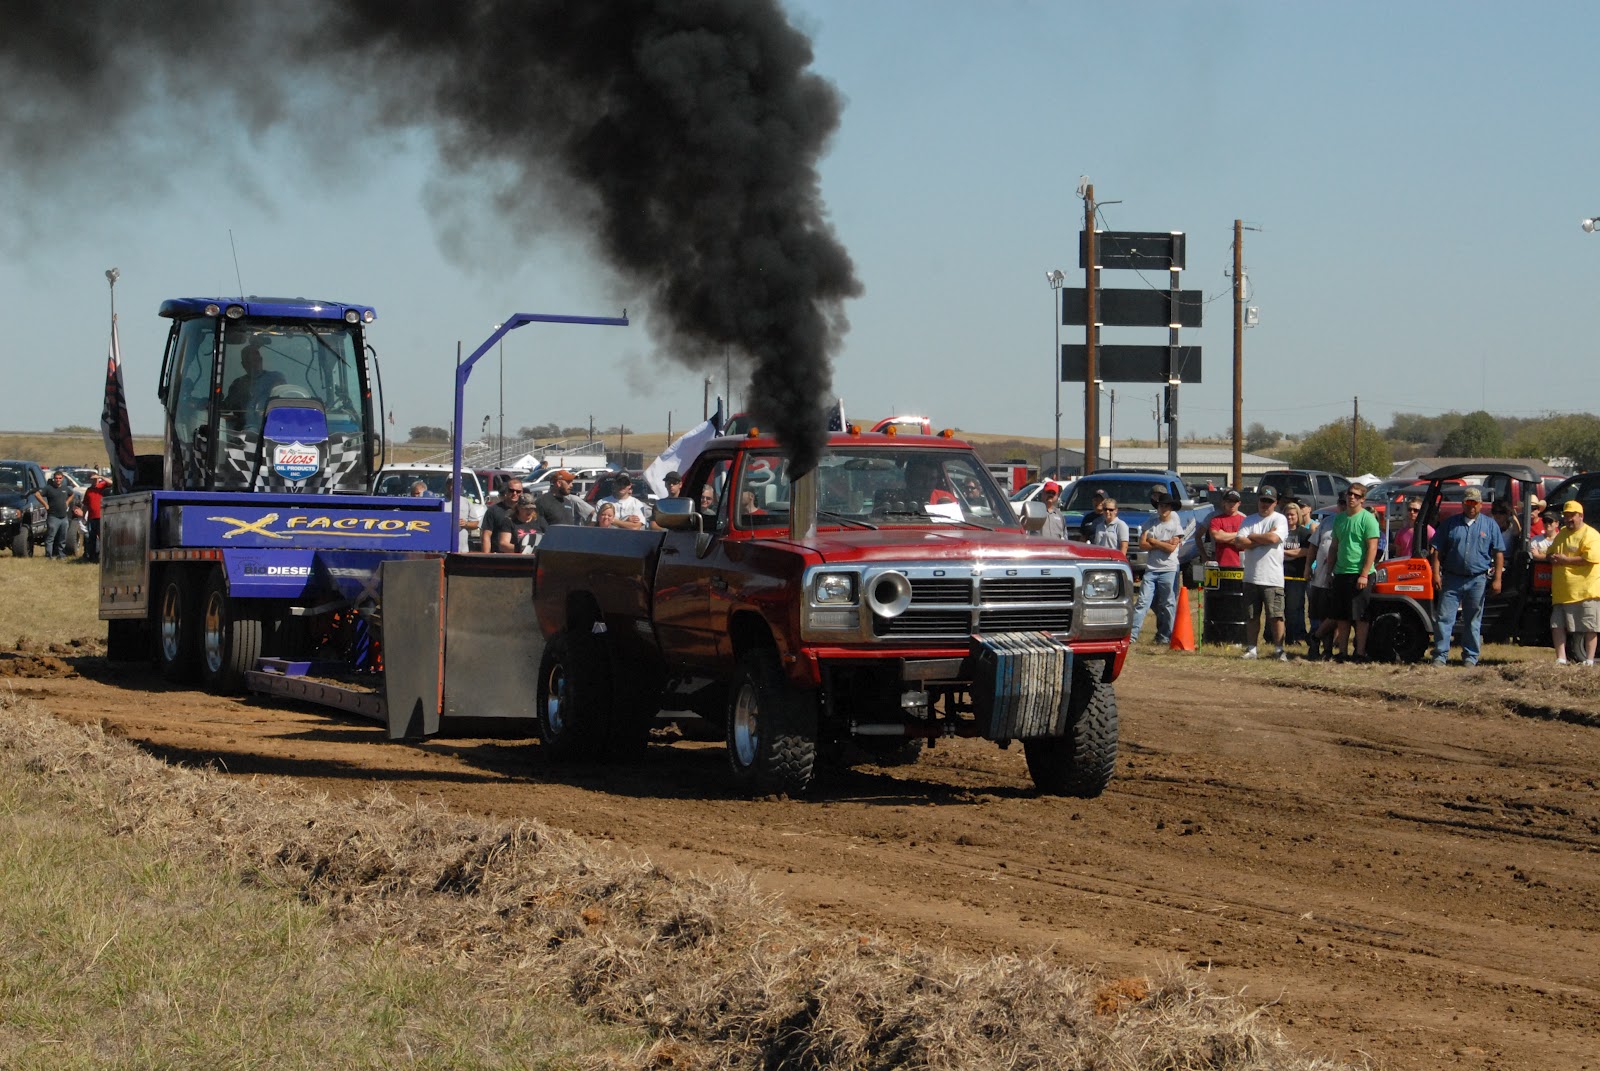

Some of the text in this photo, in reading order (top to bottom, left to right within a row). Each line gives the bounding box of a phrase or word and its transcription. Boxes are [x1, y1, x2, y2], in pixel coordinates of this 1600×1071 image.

[280, 454, 316, 464] LUCAS
[207, 513, 431, 539] X FACTOR
[244, 566, 314, 575] BIODIESEL
